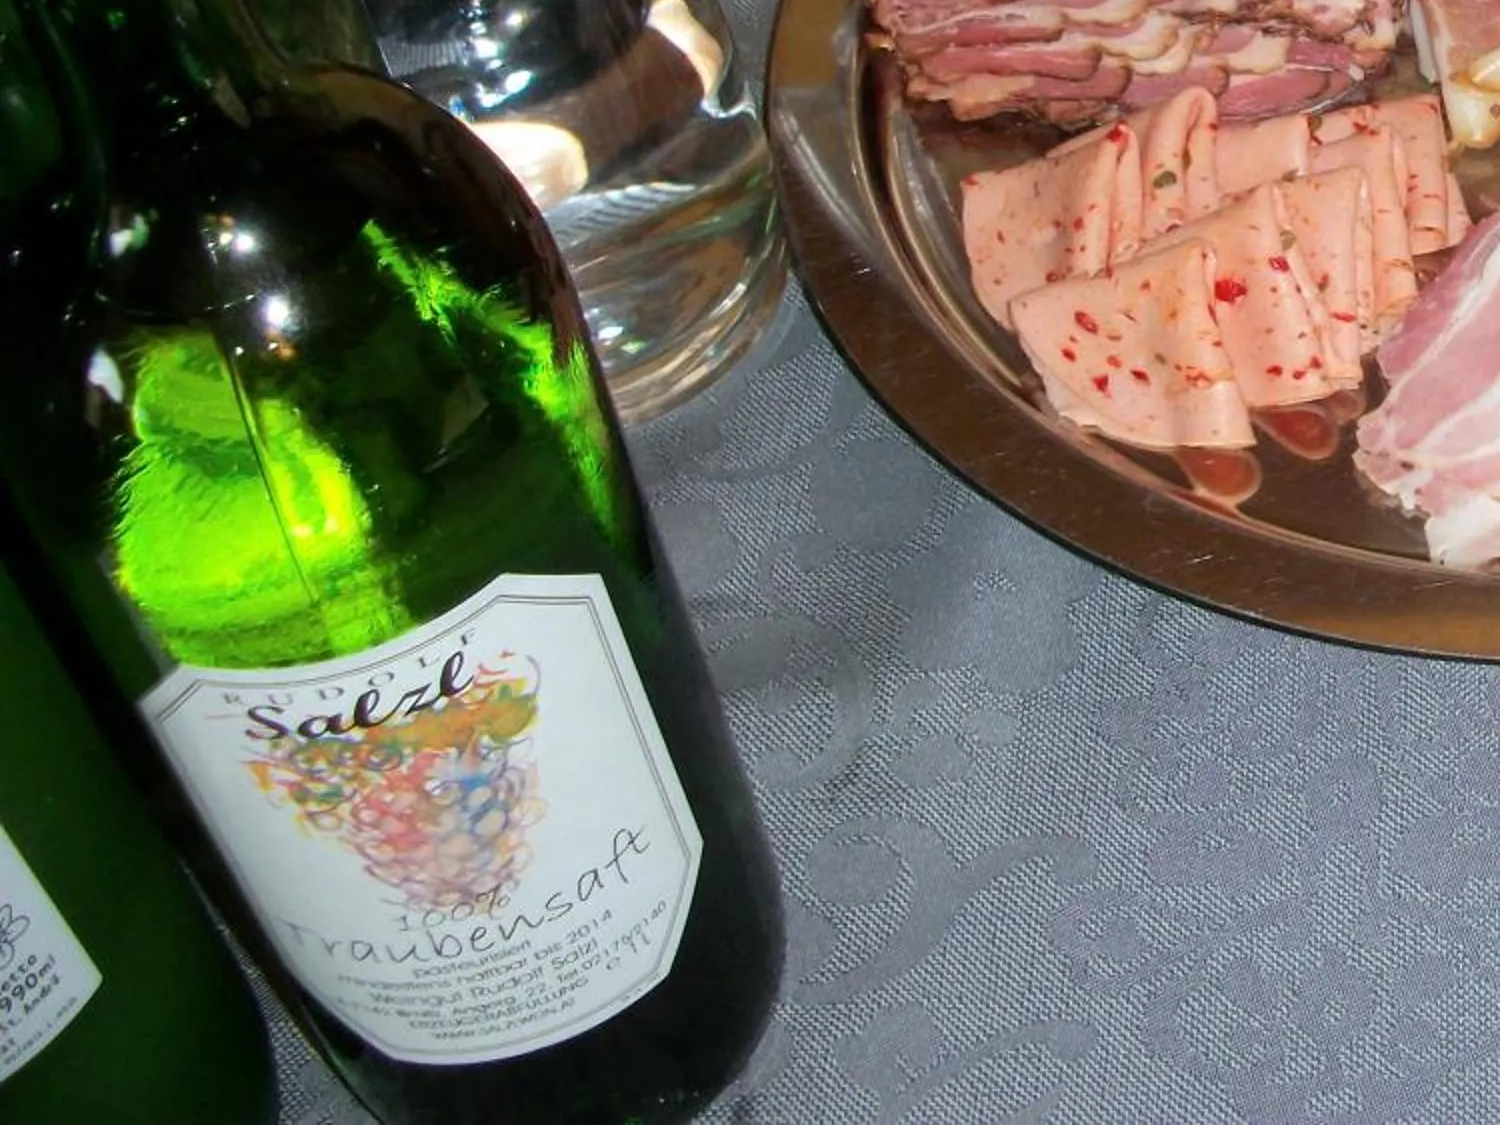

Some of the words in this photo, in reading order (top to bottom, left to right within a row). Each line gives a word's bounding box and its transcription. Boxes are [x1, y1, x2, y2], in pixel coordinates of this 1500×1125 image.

[224, 628, 475, 706] RUDOLF
[245, 651, 474, 740] Salzl
[278, 827, 651, 964] Traubensaft
[393, 884, 511, 932] 100%
[566, 909, 613, 945] 2014
[0, 955, 37, 994] etto
